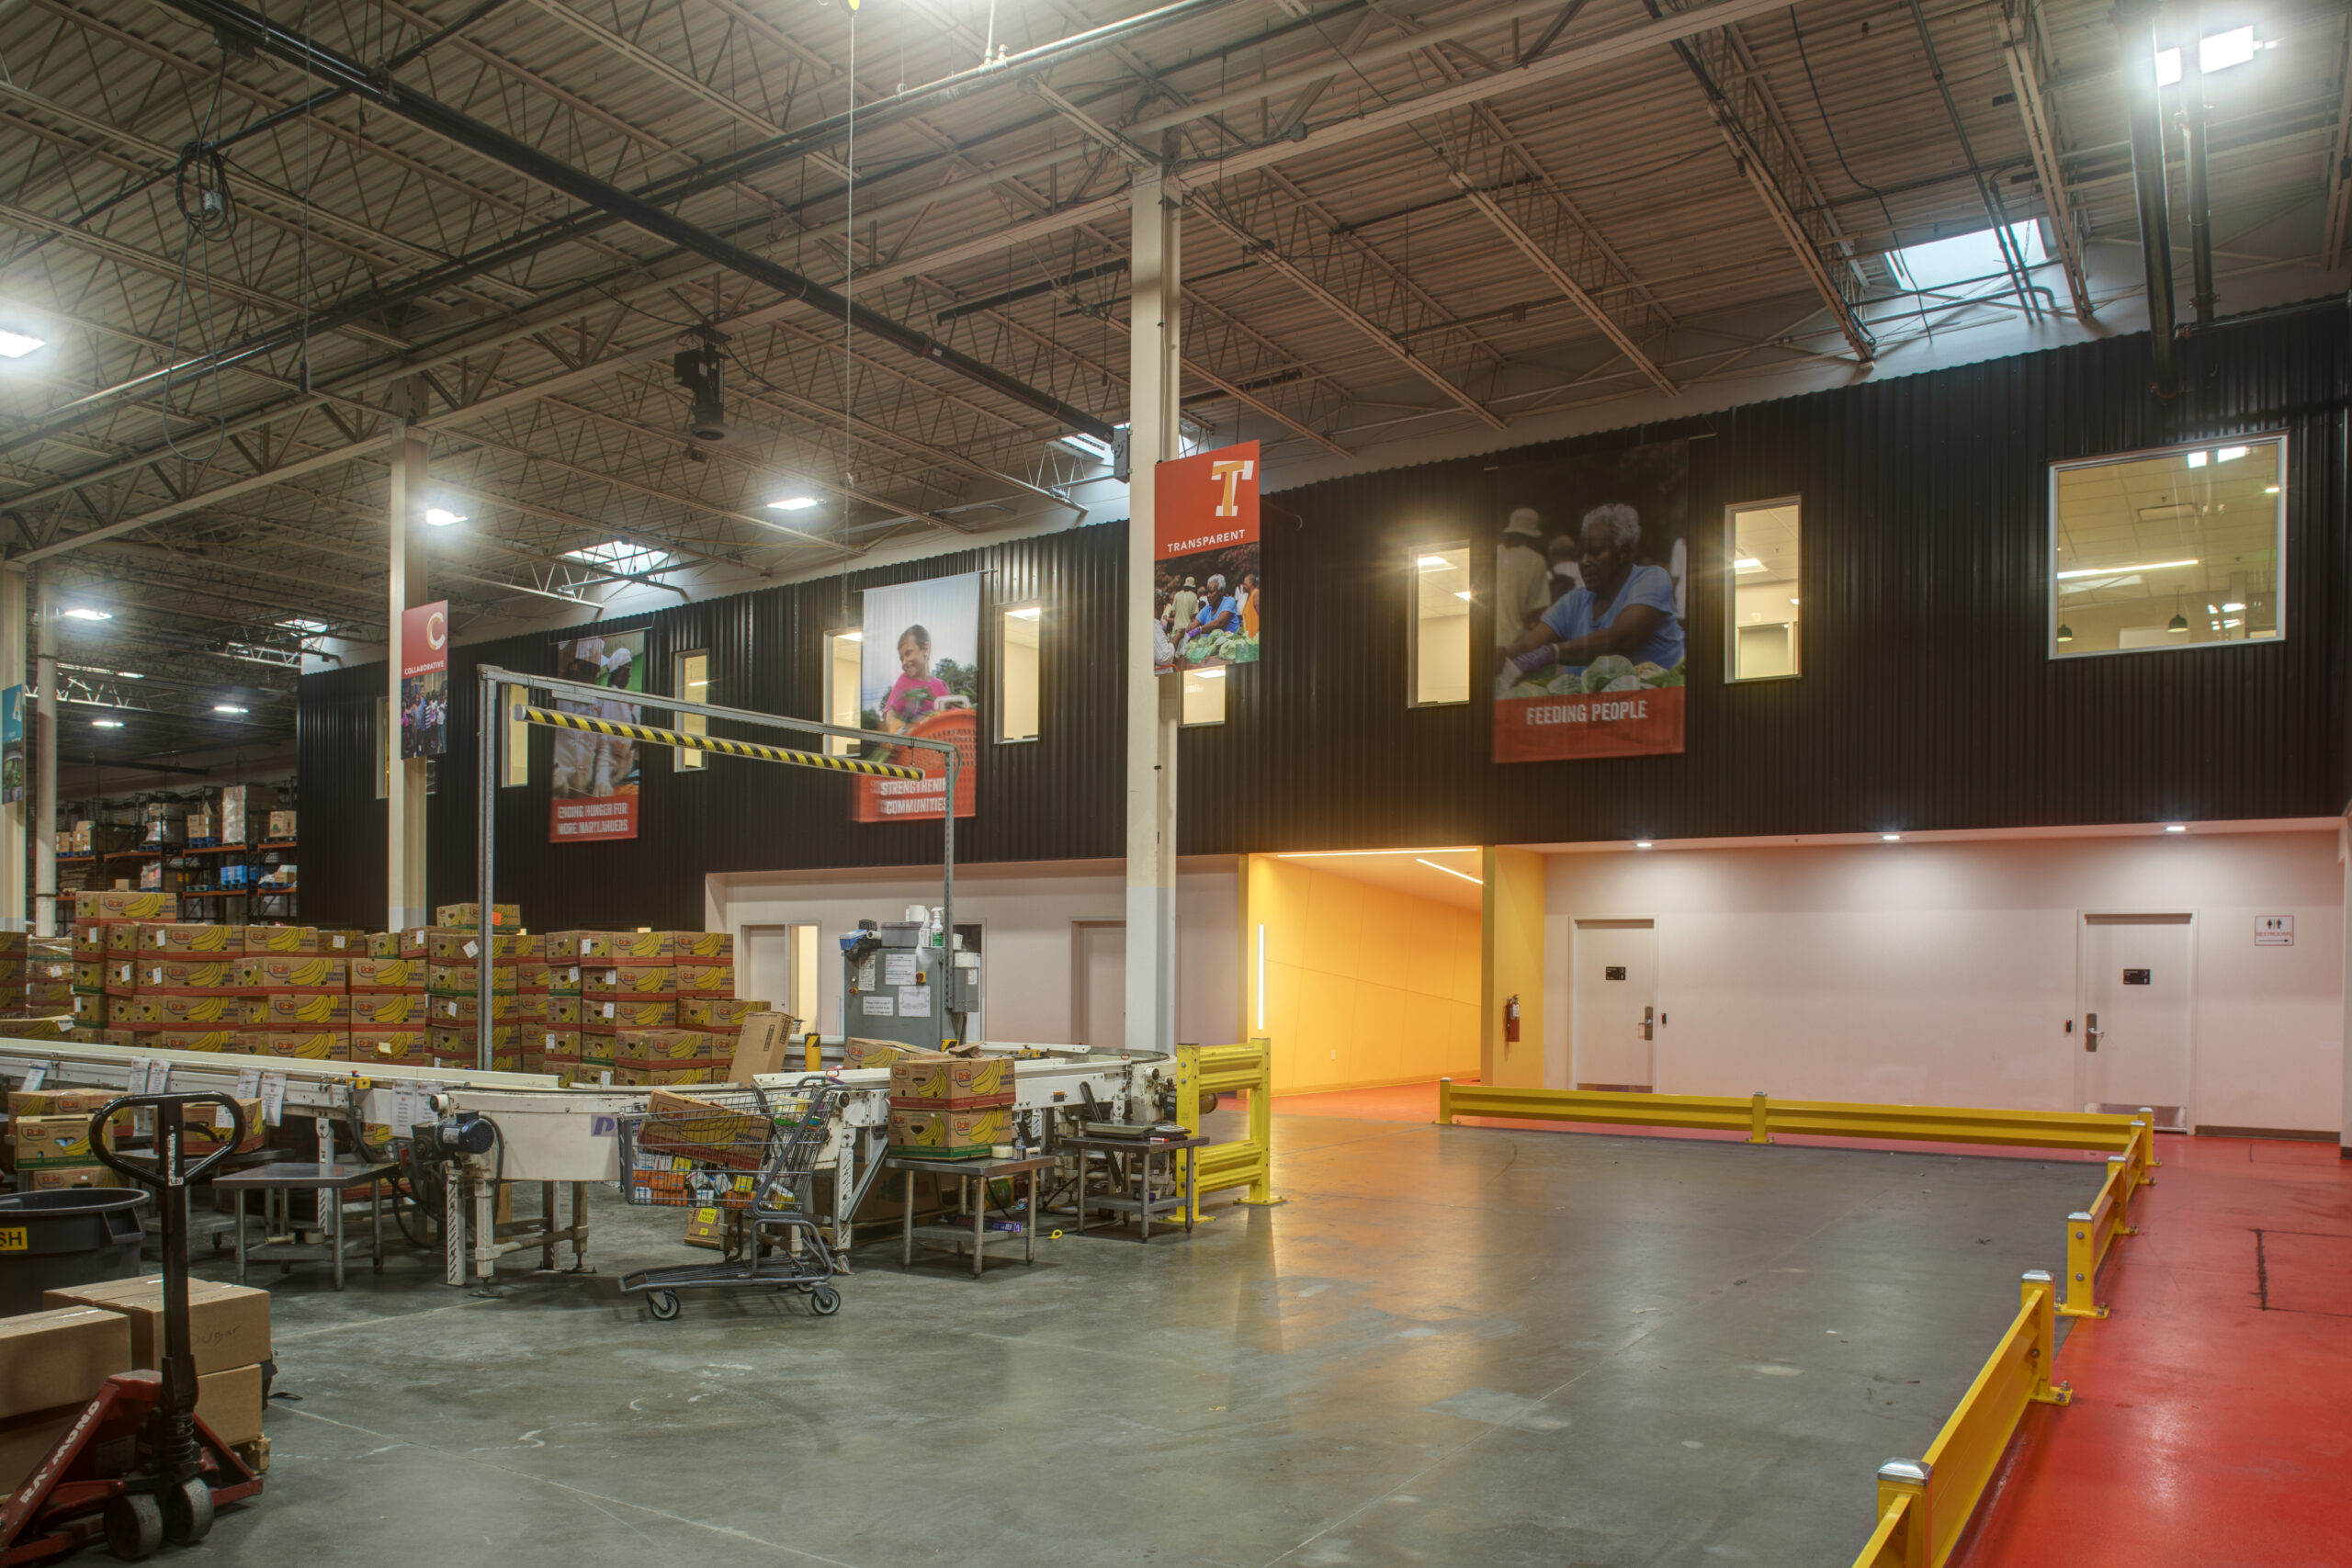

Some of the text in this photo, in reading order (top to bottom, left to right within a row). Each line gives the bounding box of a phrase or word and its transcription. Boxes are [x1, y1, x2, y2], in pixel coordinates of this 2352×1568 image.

[1211, 460, 1254, 516] T
[1167, 529, 1245, 553] TRANSPARENT
[427, 612, 446, 650] C
[404, 660, 444, 675] COLLABORATIVE
[12, 691, 22, 722] A
[1526, 700, 1648, 725] FEEDING PEOPLE
[558, 802, 628, 818] ENDING HUNGER FOR
[558, 819, 628, 834] MORE MARYLANDERS
[273, 965, 288, 974] Dole
[361, 965, 376, 974] Dole
[851, 1045, 864, 1056] Dole
[894, 1067, 907, 1077] Dole
[958, 1072, 972, 1082] Dole
[61, 1100, 79, 1109] Dole
[893, 1116, 905, 1124] Dole
[956, 1121, 970, 1131] Dole
[27, 1128, 45, 1136] Dole
